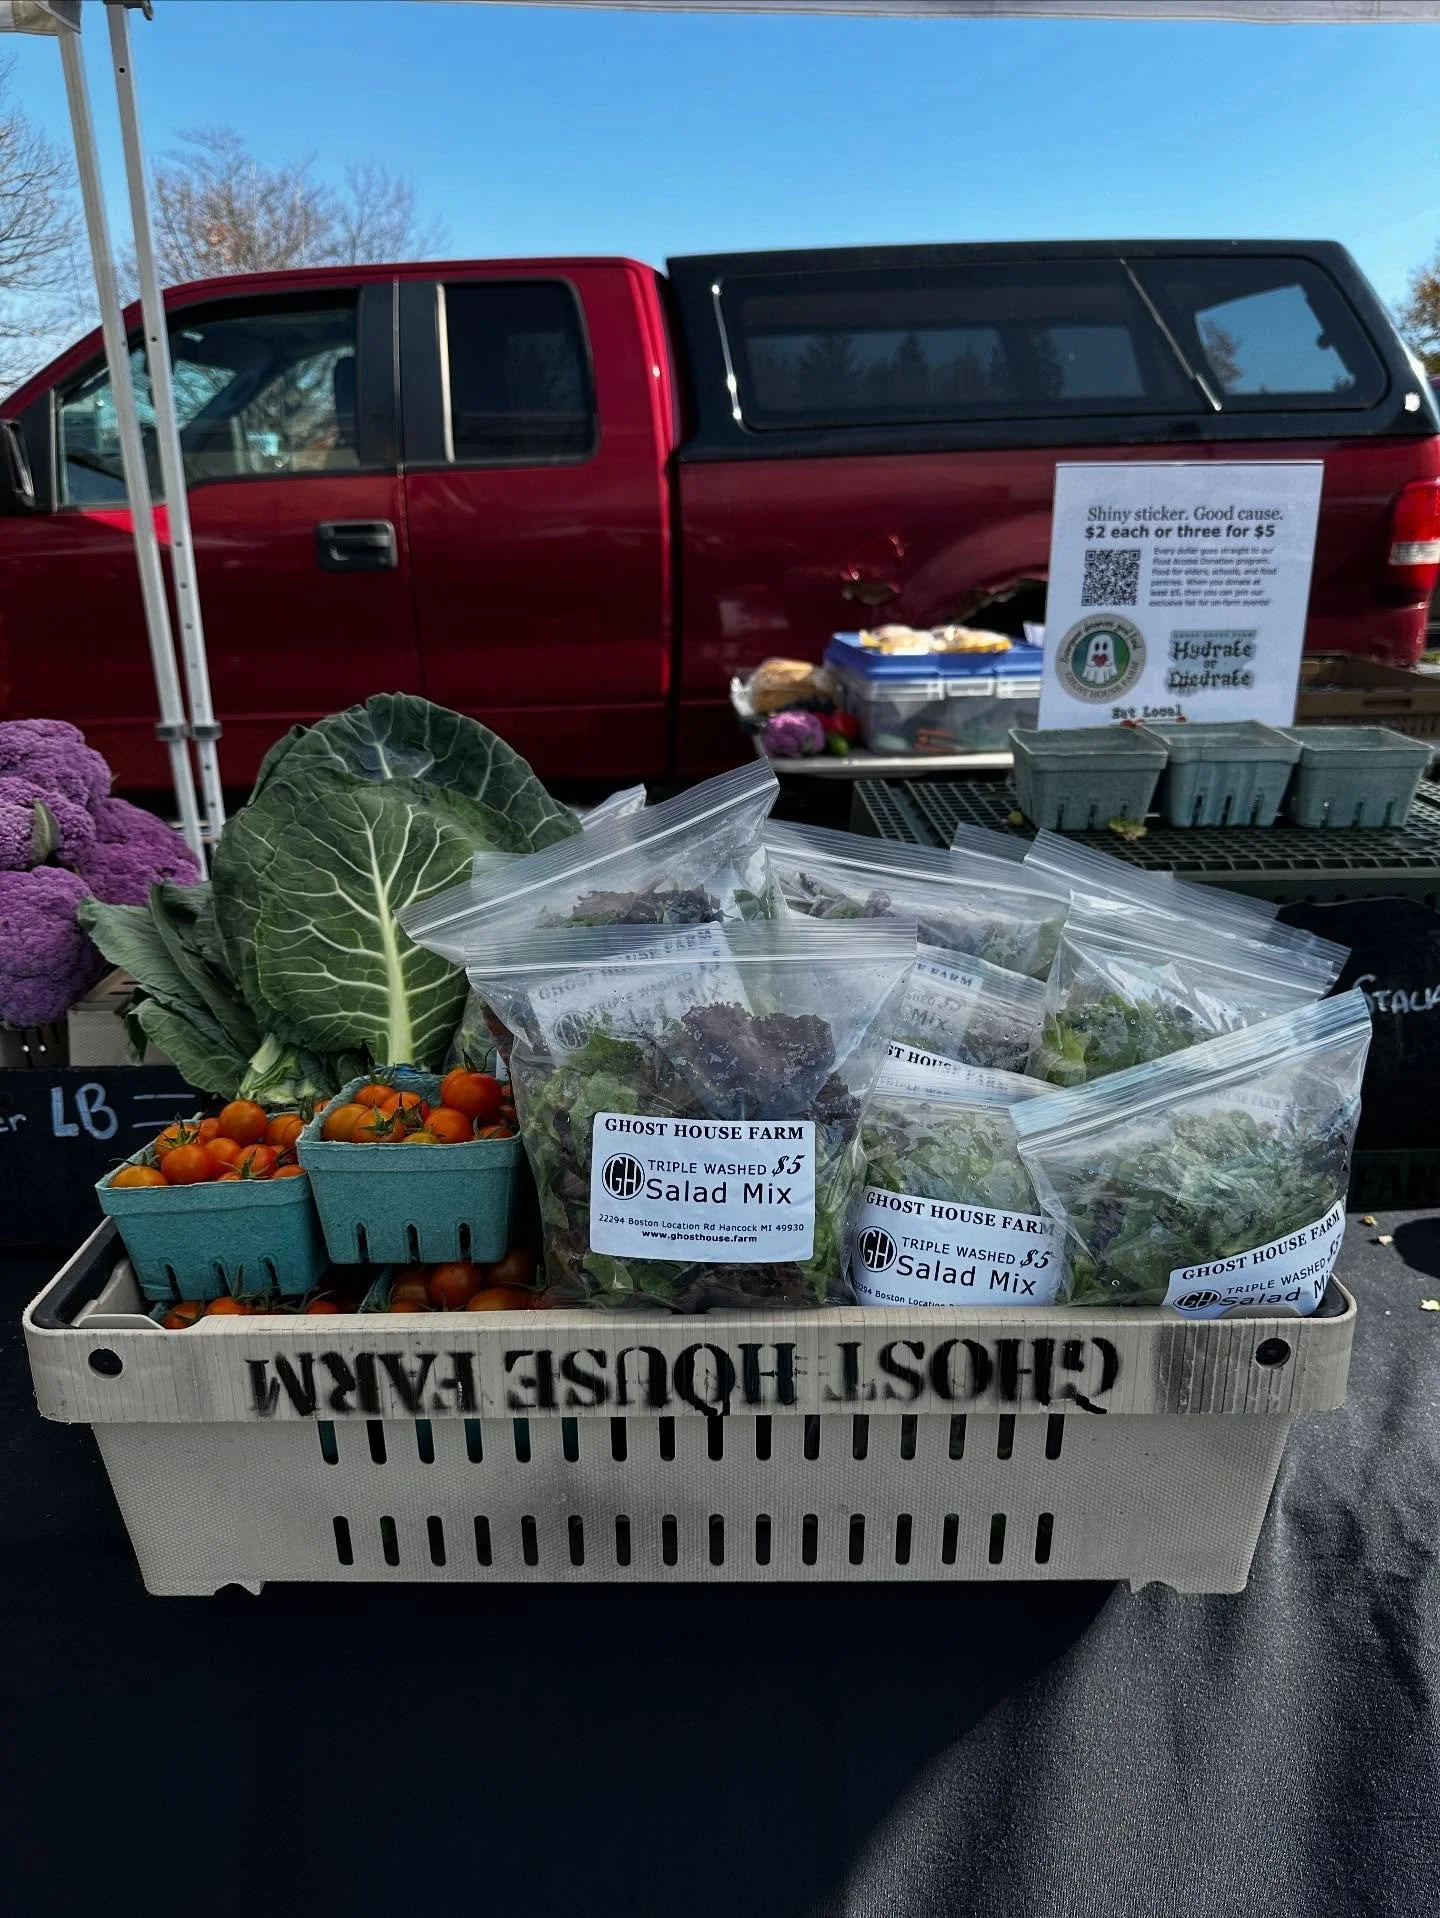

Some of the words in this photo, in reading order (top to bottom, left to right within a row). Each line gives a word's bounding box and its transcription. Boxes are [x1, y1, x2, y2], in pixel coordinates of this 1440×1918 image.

[1087, 506, 1131, 524] Shiny
[1134, 506, 1188, 521] sticker.
[1193, 505, 1233, 521] Good
[1238, 508, 1284, 521] cause.
[1085, 526, 1105, 539] $2
[1111, 525, 1149, 538] each
[1155, 528, 1172, 538] or
[1177, 525, 1221, 538] three
[1226, 525, 1250, 538] for
[1254, 525, 1275, 539] $5
[1172, 640, 1254, 660] Hydrate
[1203, 660, 1218, 669] or
[1143, 704, 1182, 718] Local
[51, 1082, 118, 1140] LB
[605, 1118, 667, 1137] GHOST
[674, 1124, 742, 1140] HOUSE
[748, 1126, 804, 1140] FARM
[648, 1159, 697, 1174] TRIPLE
[704, 1163, 767, 1176] WASHED
[772, 1154, 805, 1178] $5
[646, 1178, 728, 1205] Salad
[743, 1183, 792, 1205] Mix
[599, 1214, 625, 1225] 22294
[628, 1217, 659, 1228] Boston
[662, 1220, 700, 1230] Location
[703, 1221, 716, 1231] Rd
[719, 1222, 757, 1232] Hancock
[760, 1223, 772, 1232] MI
[775, 1223, 804, 1231] 49930
[866, 1191, 925, 1215] GHOST
[931, 1205, 996, 1227] HOUSE
[1002, 1216, 1056, 1236] FARM
[642, 1231, 758, 1243] www.ghosthouse.farm
[1182, 1256, 1247, 1280] GHOST
[1253, 1233, 1307, 1265] HOUSE
[1310, 1209, 1340, 1241] FARM
[902, 1236, 950, 1255] TRIPLE
[957, 1245, 1016, 1265] WASHED
[1020, 1249, 1052, 1269] $5
[896, 1255, 976, 1287] Salad
[989, 1269, 1037, 1296] Mix
[1227, 1279, 1275, 1295] TRIPLE
[1280, 1257, 1326, 1286] WASHED
[875, 1289, 905, 1303] Boston
[1219, 1287, 1301, 1306] Salad
[245, 1350, 482, 1417] FARM
[503, 1342, 798, 1415] HOUSE
[823, 1336, 1120, 1414] GHOST
